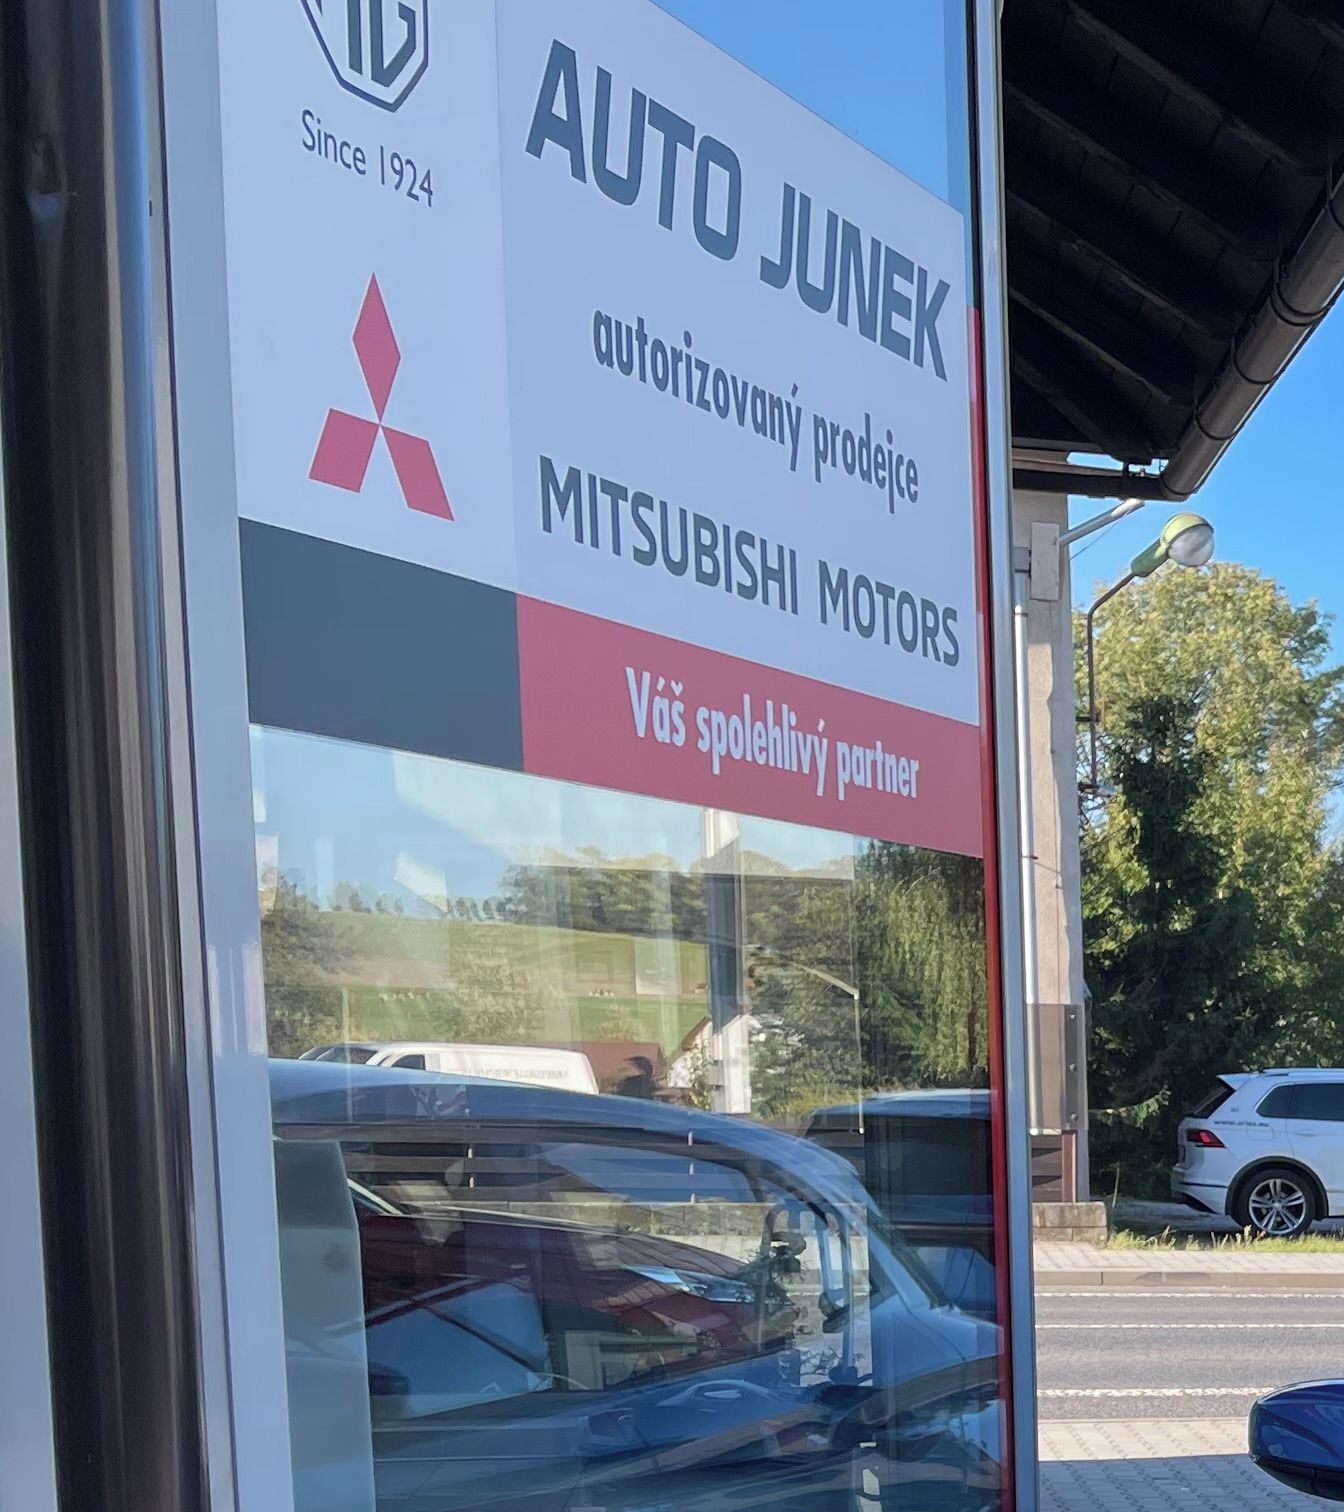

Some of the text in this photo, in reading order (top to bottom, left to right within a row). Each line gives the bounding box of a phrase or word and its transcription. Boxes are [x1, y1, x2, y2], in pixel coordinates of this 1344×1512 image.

[301, 108, 434, 208] Since 1924
[524, 38, 951, 382] AUTO JUNEK
[592, 308, 920, 515] autorizovaný prodejce
[538, 455, 960, 667] MITSUBISHI MOTORS
[624, 665, 920, 801] Váš spolehlivý partner
